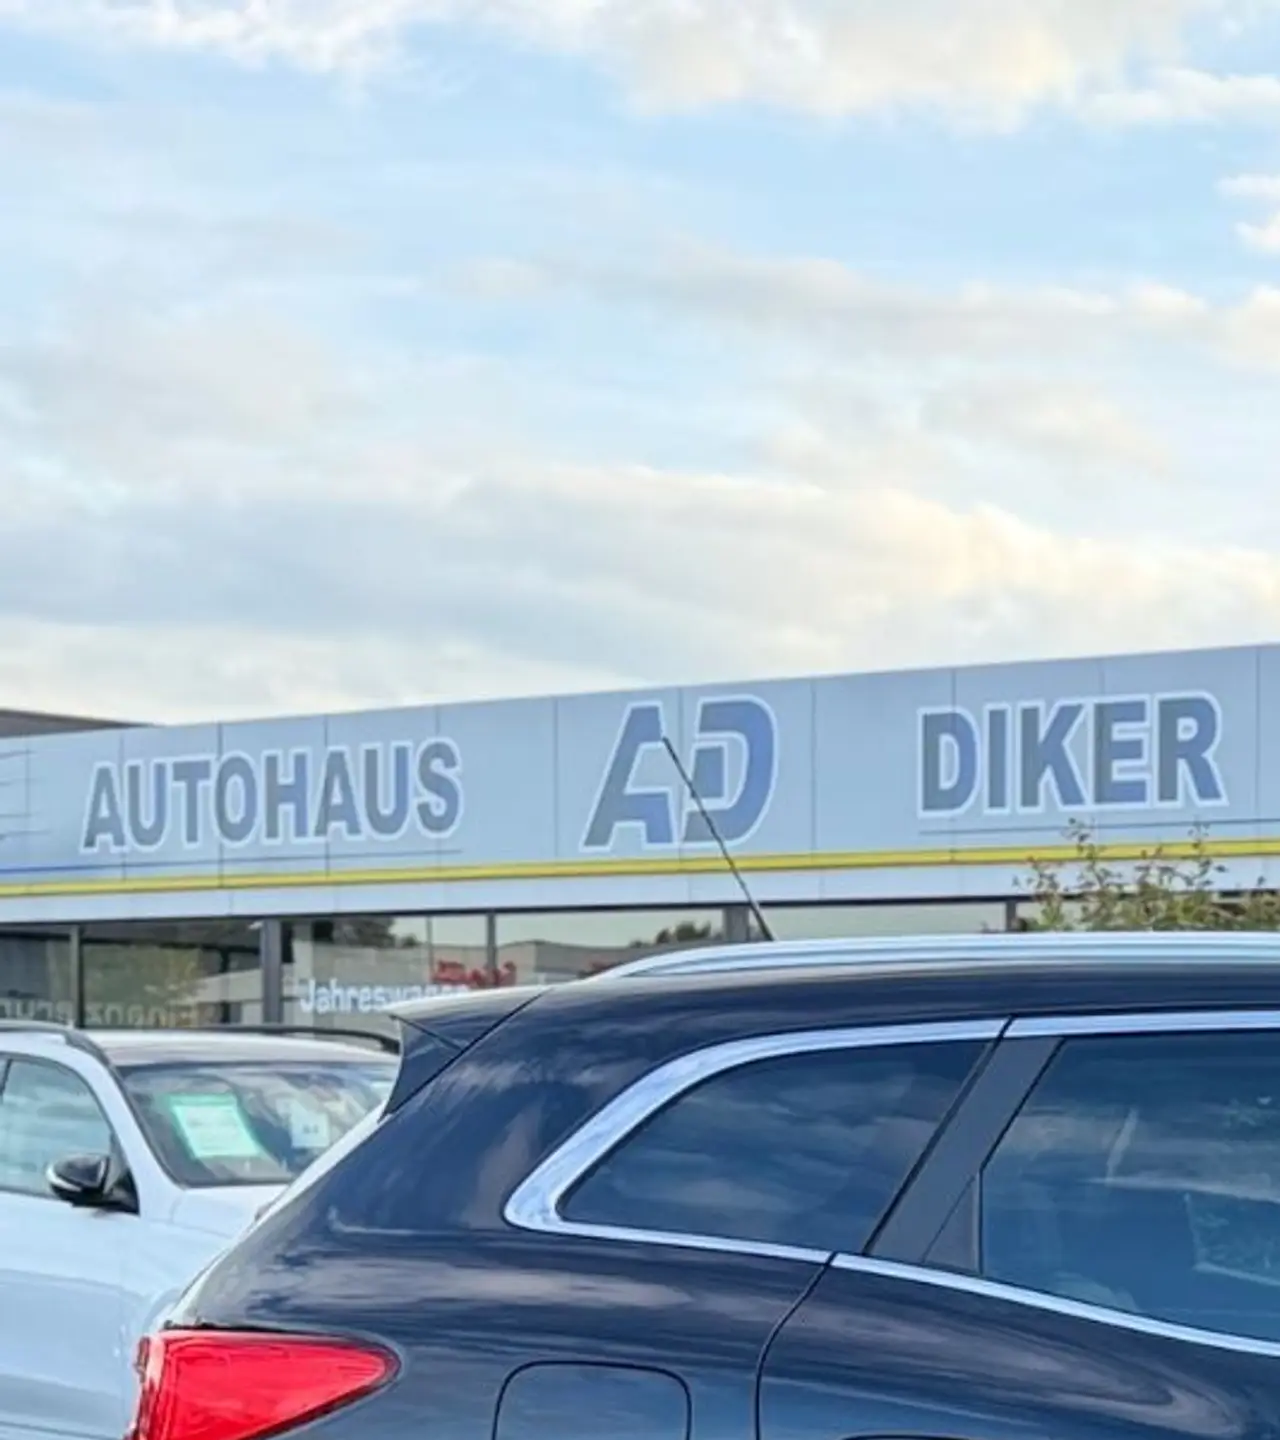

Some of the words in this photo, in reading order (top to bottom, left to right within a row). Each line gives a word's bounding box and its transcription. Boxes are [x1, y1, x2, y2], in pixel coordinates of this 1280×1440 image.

[80, 737, 463, 852] AUTOHAUS
[580, 695, 778, 852] AD
[918, 691, 1229, 818] DIKER
